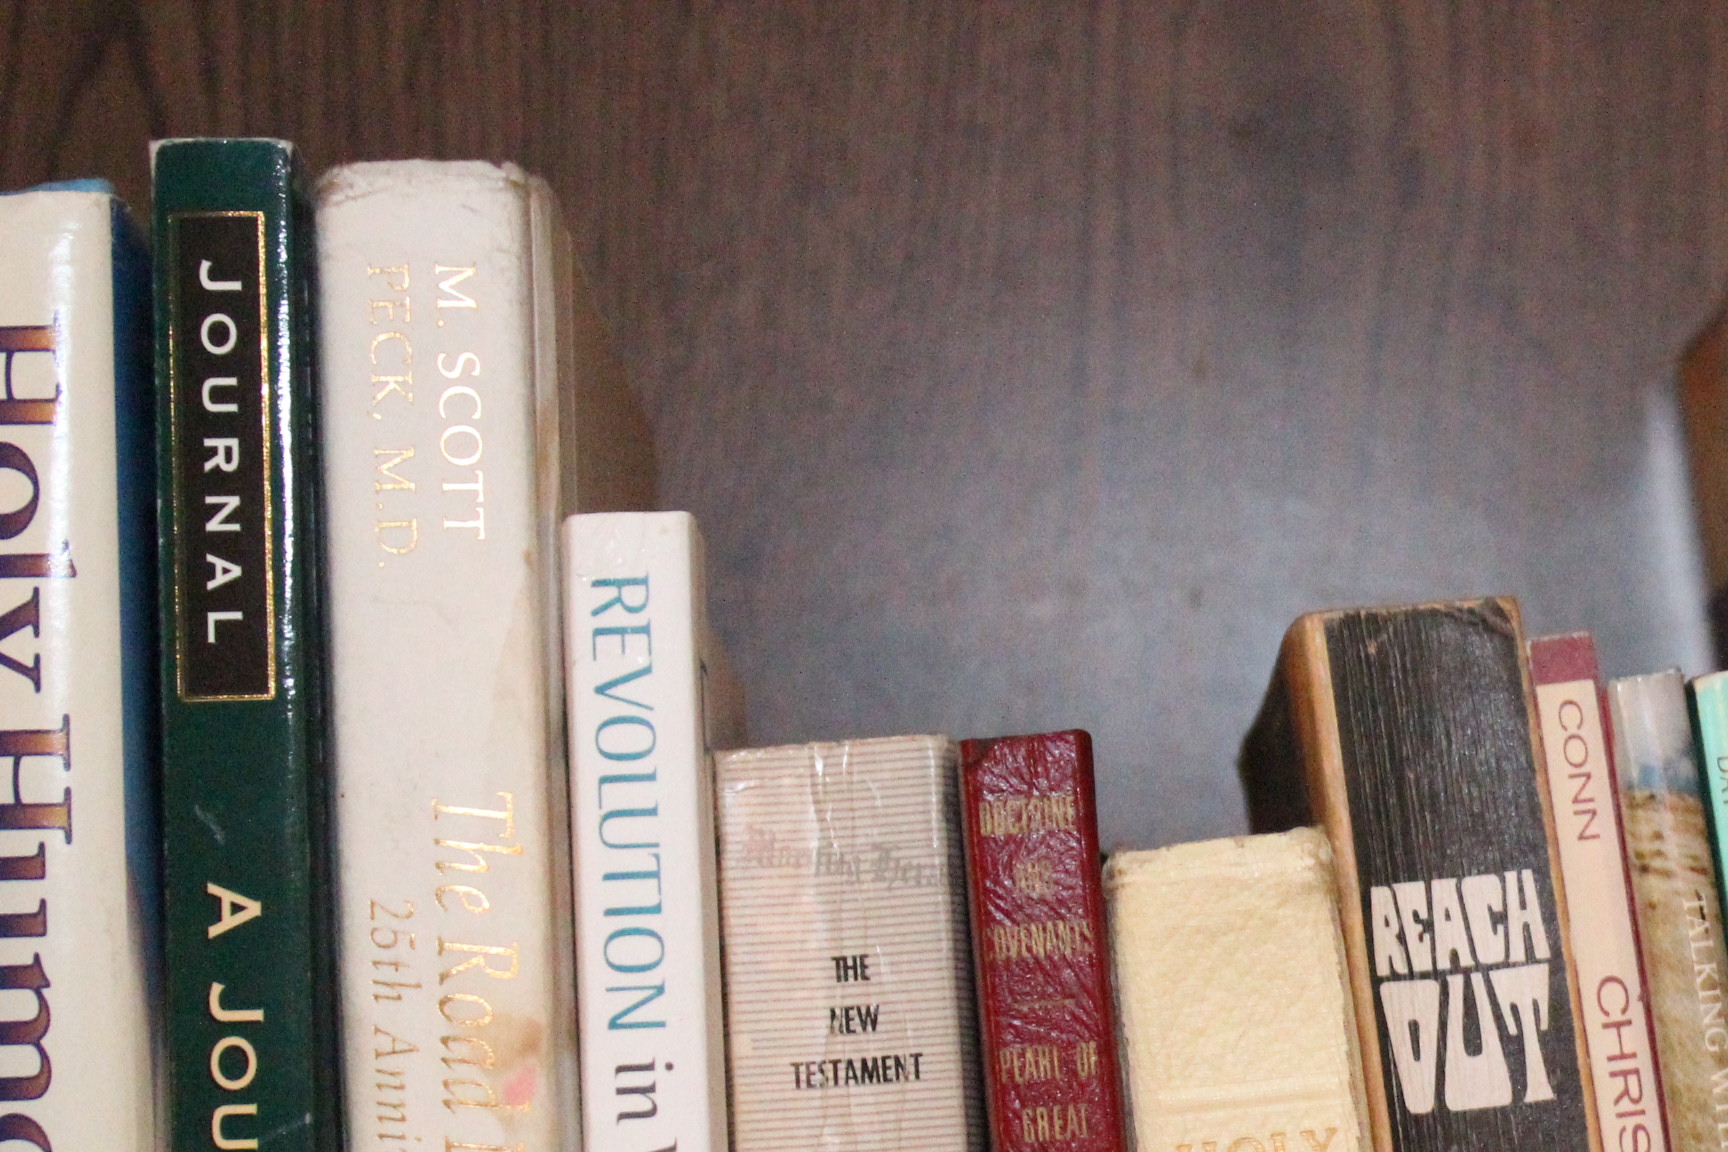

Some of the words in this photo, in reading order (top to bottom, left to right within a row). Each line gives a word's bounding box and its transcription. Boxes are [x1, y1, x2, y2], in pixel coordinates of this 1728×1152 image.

[367, 262, 415, 420] PECK,
[434, 262, 478, 328] M.
[197, 258, 244, 645] JOURNAL
[436, 350, 485, 541] SCOTT
[374, 445, 420, 568] M.D.
[590, 571, 668, 1032] REVOLUTION
[1557, 699, 1601, 842] CONN
[433, 791, 524, 917] The
[206, 881, 262, 940] A
[367, 897, 423, 1004] 25th
[1370, 868, 1552, 978] REACH
[828, 1004, 880, 1036] NEW
[830, 953, 872, 984] THE
[436, 941, 531, 1114] Road
[790, 1052, 925, 1090] TESTAMENT
[1000, 1043, 1062, 1086] PEARL
[1379, 963, 1557, 1115] OUT
[614, 1055, 675, 1127] in
[1021, 1104, 1090, 1145] GREAT
